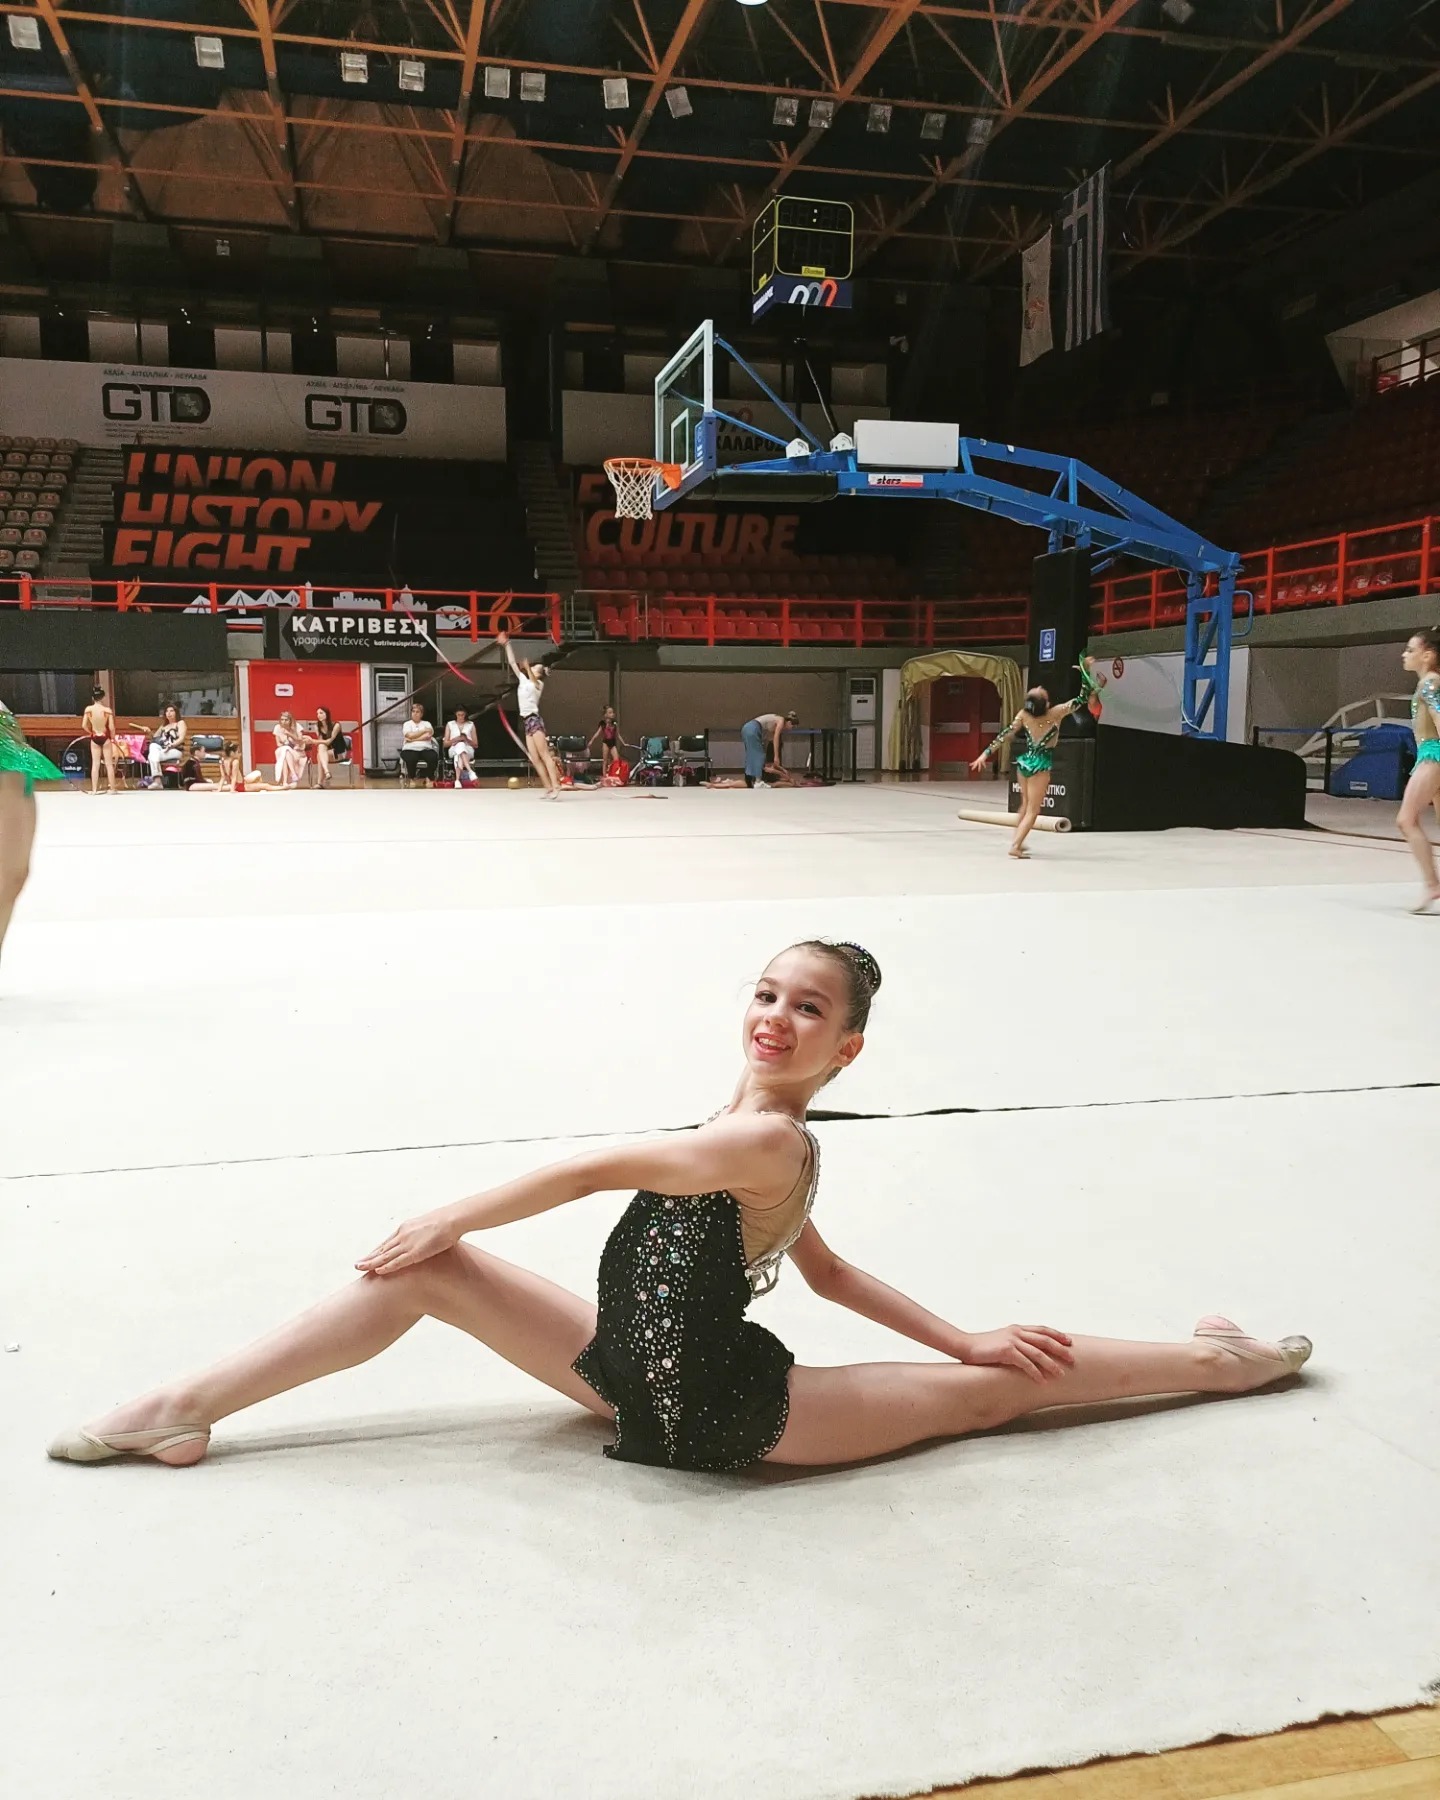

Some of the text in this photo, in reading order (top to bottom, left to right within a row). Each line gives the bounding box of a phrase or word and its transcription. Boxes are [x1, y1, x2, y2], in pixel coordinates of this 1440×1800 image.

[102, 382, 211, 424] GTD
[305, 394, 407, 435] GTD
[586, 510, 800, 555] CULTURE
[292, 616, 428, 635] ΚΑΤΡΙΒΕΣΗ
[292, 636, 370, 647] γραφικές τέχνες
